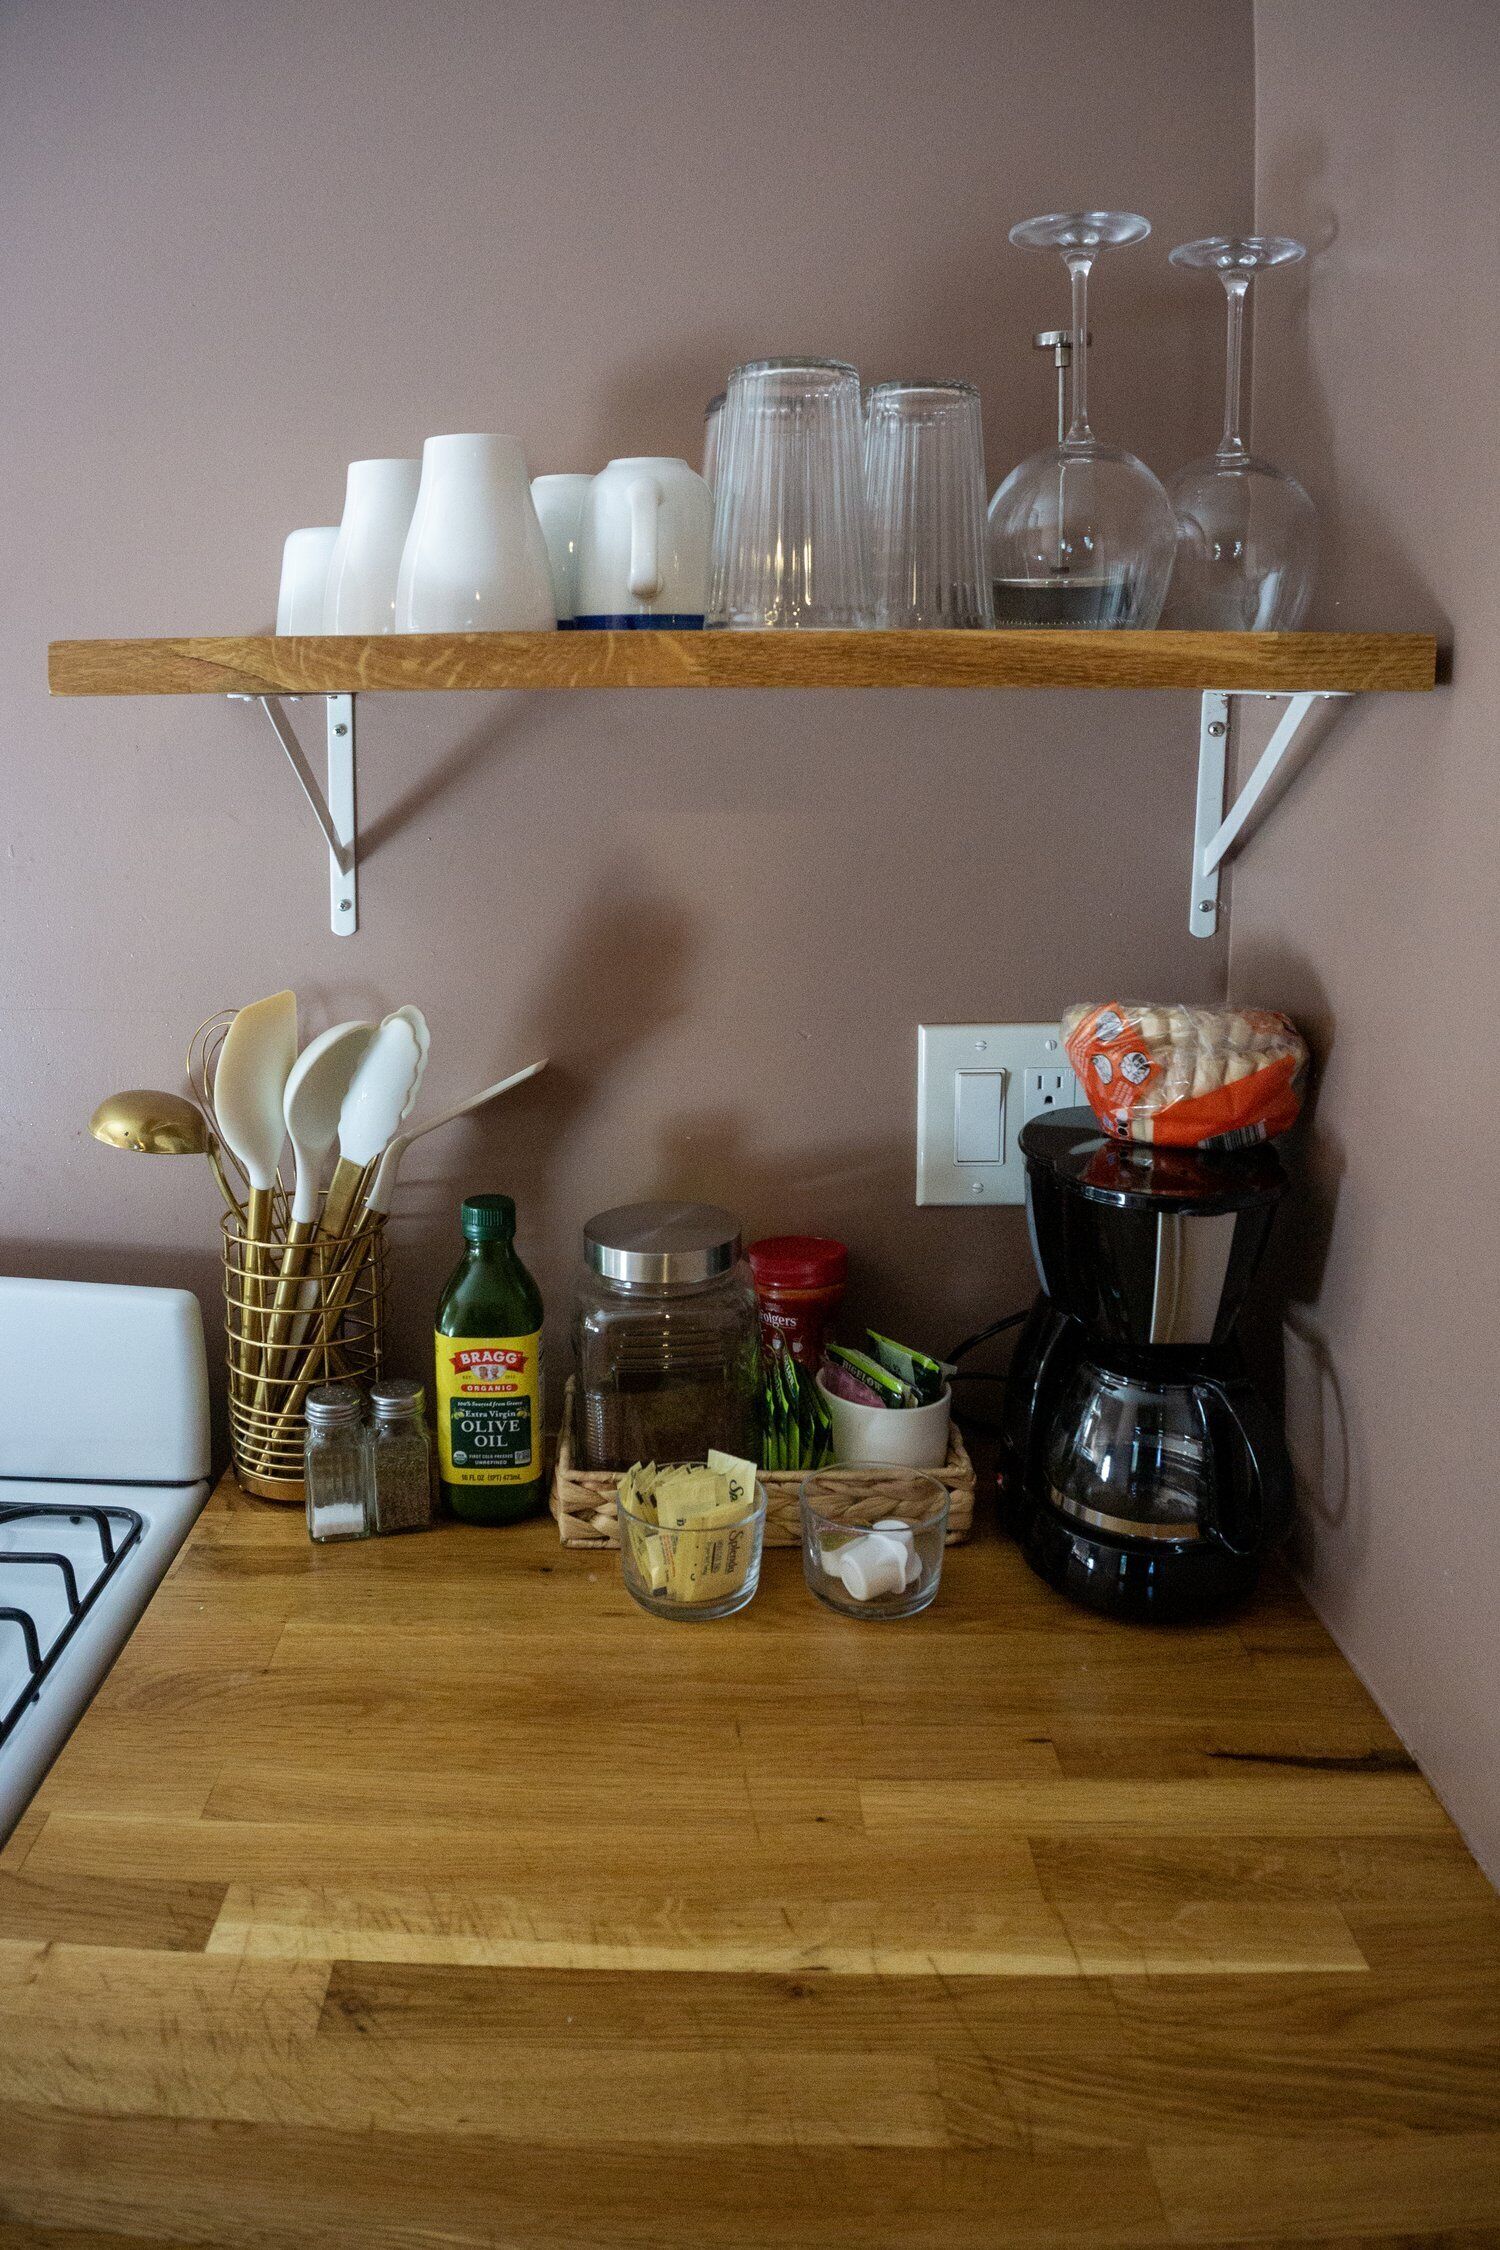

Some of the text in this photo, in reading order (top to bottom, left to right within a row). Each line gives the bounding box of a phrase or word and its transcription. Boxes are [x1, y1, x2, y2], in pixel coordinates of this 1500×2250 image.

[460, 1351, 517, 1365] BRAGG
[465, 1410, 516, 1420] Extra Virgin
[461, 1420, 520, 1433] OLIVE
[474, 1434, 508, 1447] OIL
[727, 1531, 744, 1573] Splenda
